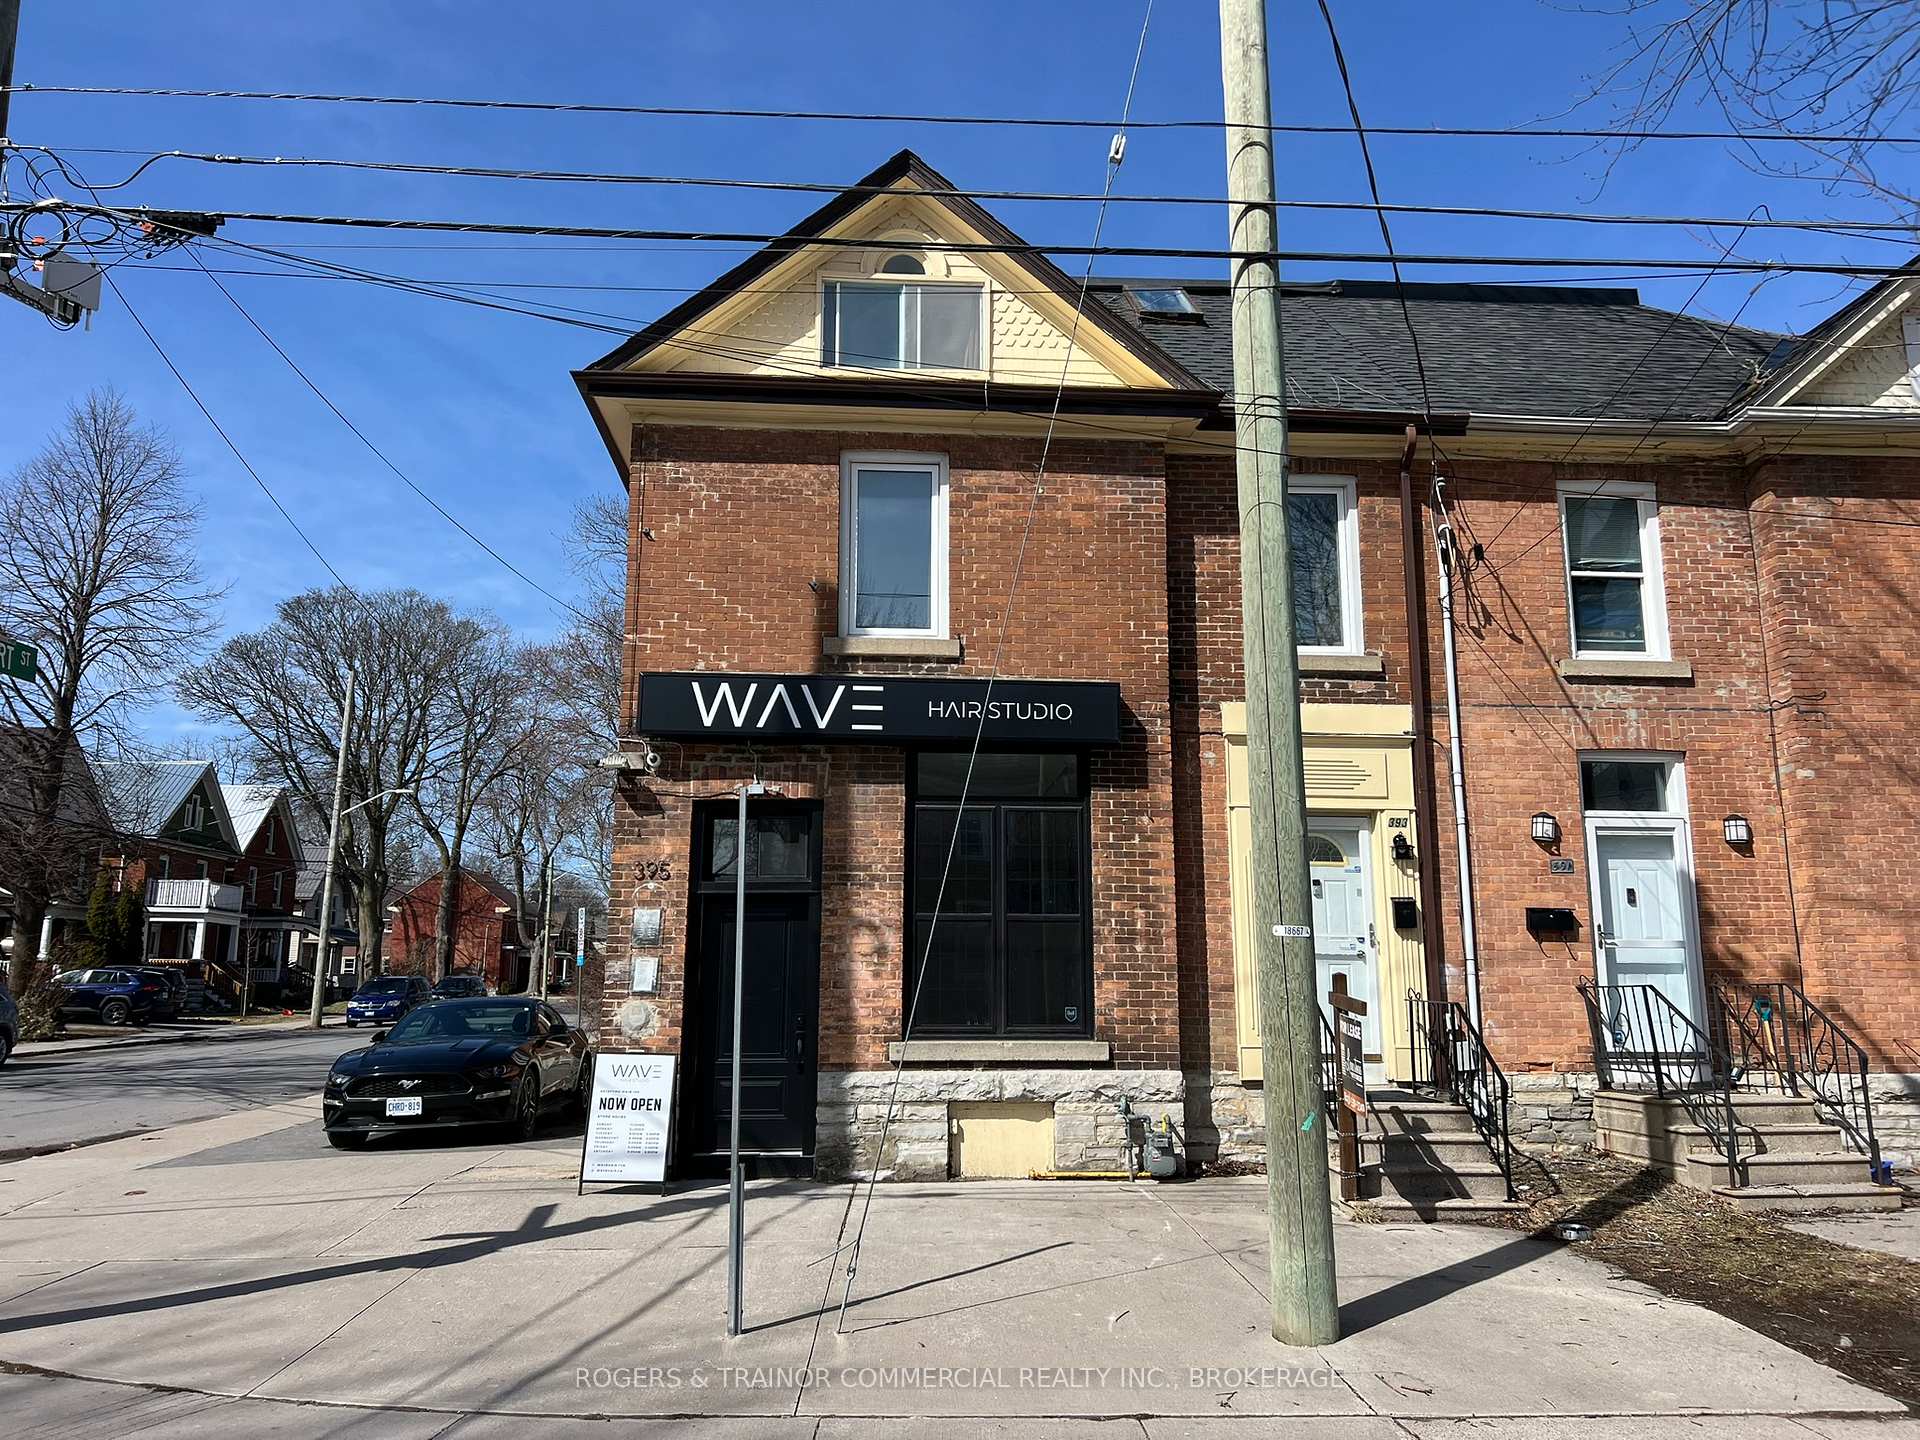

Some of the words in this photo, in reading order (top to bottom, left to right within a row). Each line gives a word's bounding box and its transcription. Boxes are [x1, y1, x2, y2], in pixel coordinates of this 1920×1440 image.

[20, 650, 31, 666] ST
[692, 681, 884, 730] WAVE
[1388, 817, 1408, 827] 393
[611, 1064, 662, 1079] WAVE
[599, 1097, 627, 1110] NOW
[630, 1098, 662, 1111] OPEN
